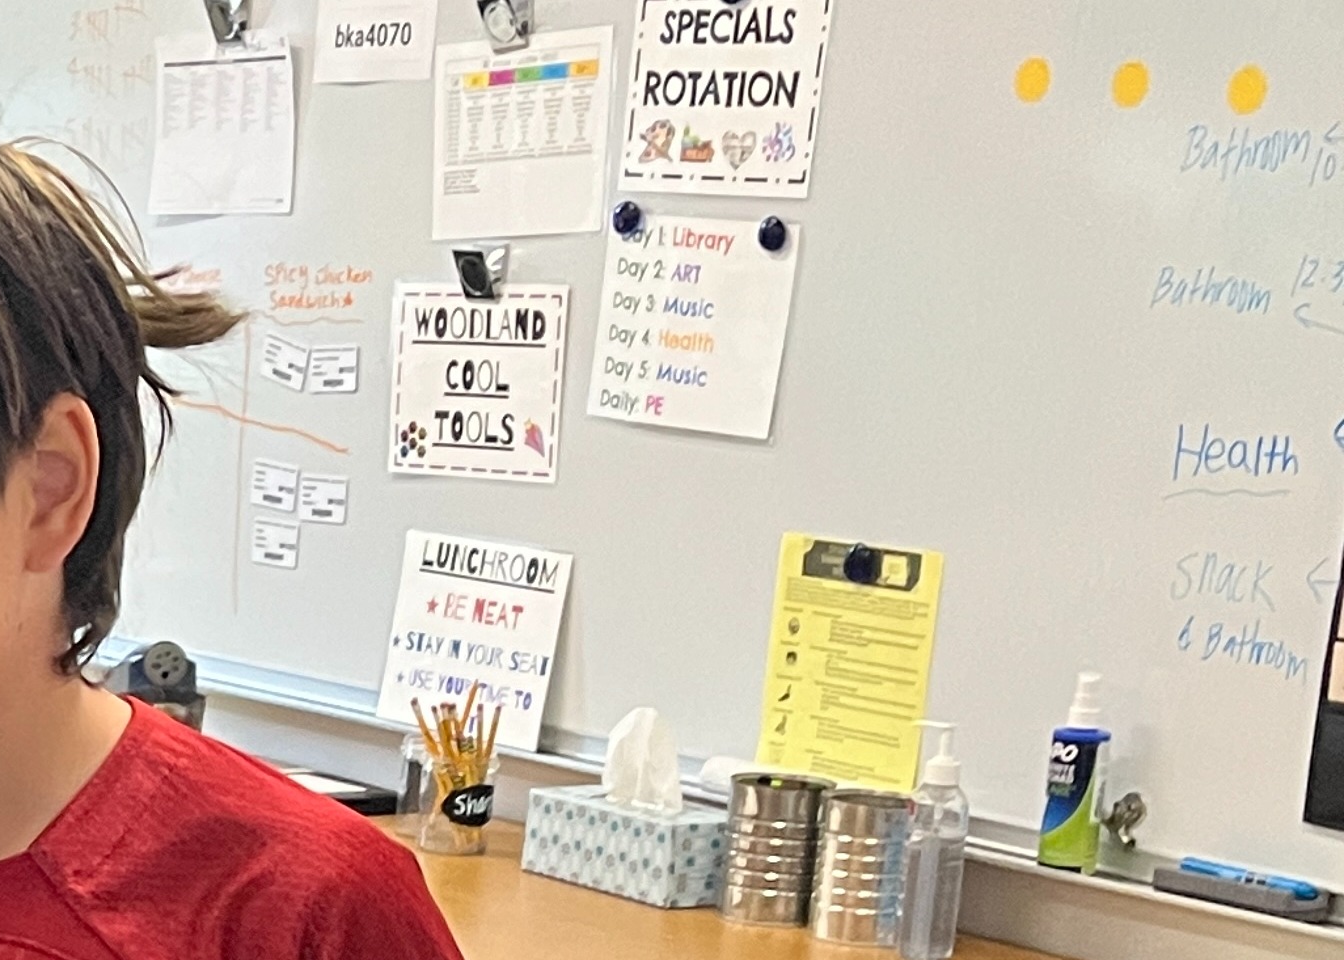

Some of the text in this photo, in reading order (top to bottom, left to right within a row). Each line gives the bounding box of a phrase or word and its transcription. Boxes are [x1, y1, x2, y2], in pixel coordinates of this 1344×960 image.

[334, 21, 413, 49] bka4070
[660, 6, 797, 45] SPECIALS
[642, 69, 801, 109] ROTATION
[1180, 124, 1312, 182] Bathroom
[672, 226, 736, 256] Library
[617, 257, 649, 283] Day
[670, 264, 702, 284] ART
[612, 291, 641, 315] Day
[662, 296, 715, 320] Music
[1149, 265, 1271, 315] Bathroom
[414, 306, 547, 342] WOODLAND
[608, 323, 637, 349] Day
[658, 328, 715, 354] Health
[445, 359, 511, 393] COOL
[604, 356, 633, 382] Day
[656, 364, 708, 388] Music
[644, 395, 665, 416] PE
[433, 410, 516, 445] TOOLS
[1172, 422, 1299, 482] Health
[421, 539, 560, 588] LUNCHROOM
[443, 592, 524, 631] BE NEAT
[406, 630, 445, 655] STAY
[465, 642, 504, 669] YOUR
[508, 650, 550, 677] SEAT
[1200, 619, 1309, 685] Bathroom
[408, 669, 434, 691] USE
[514, 689, 533, 711] TO
